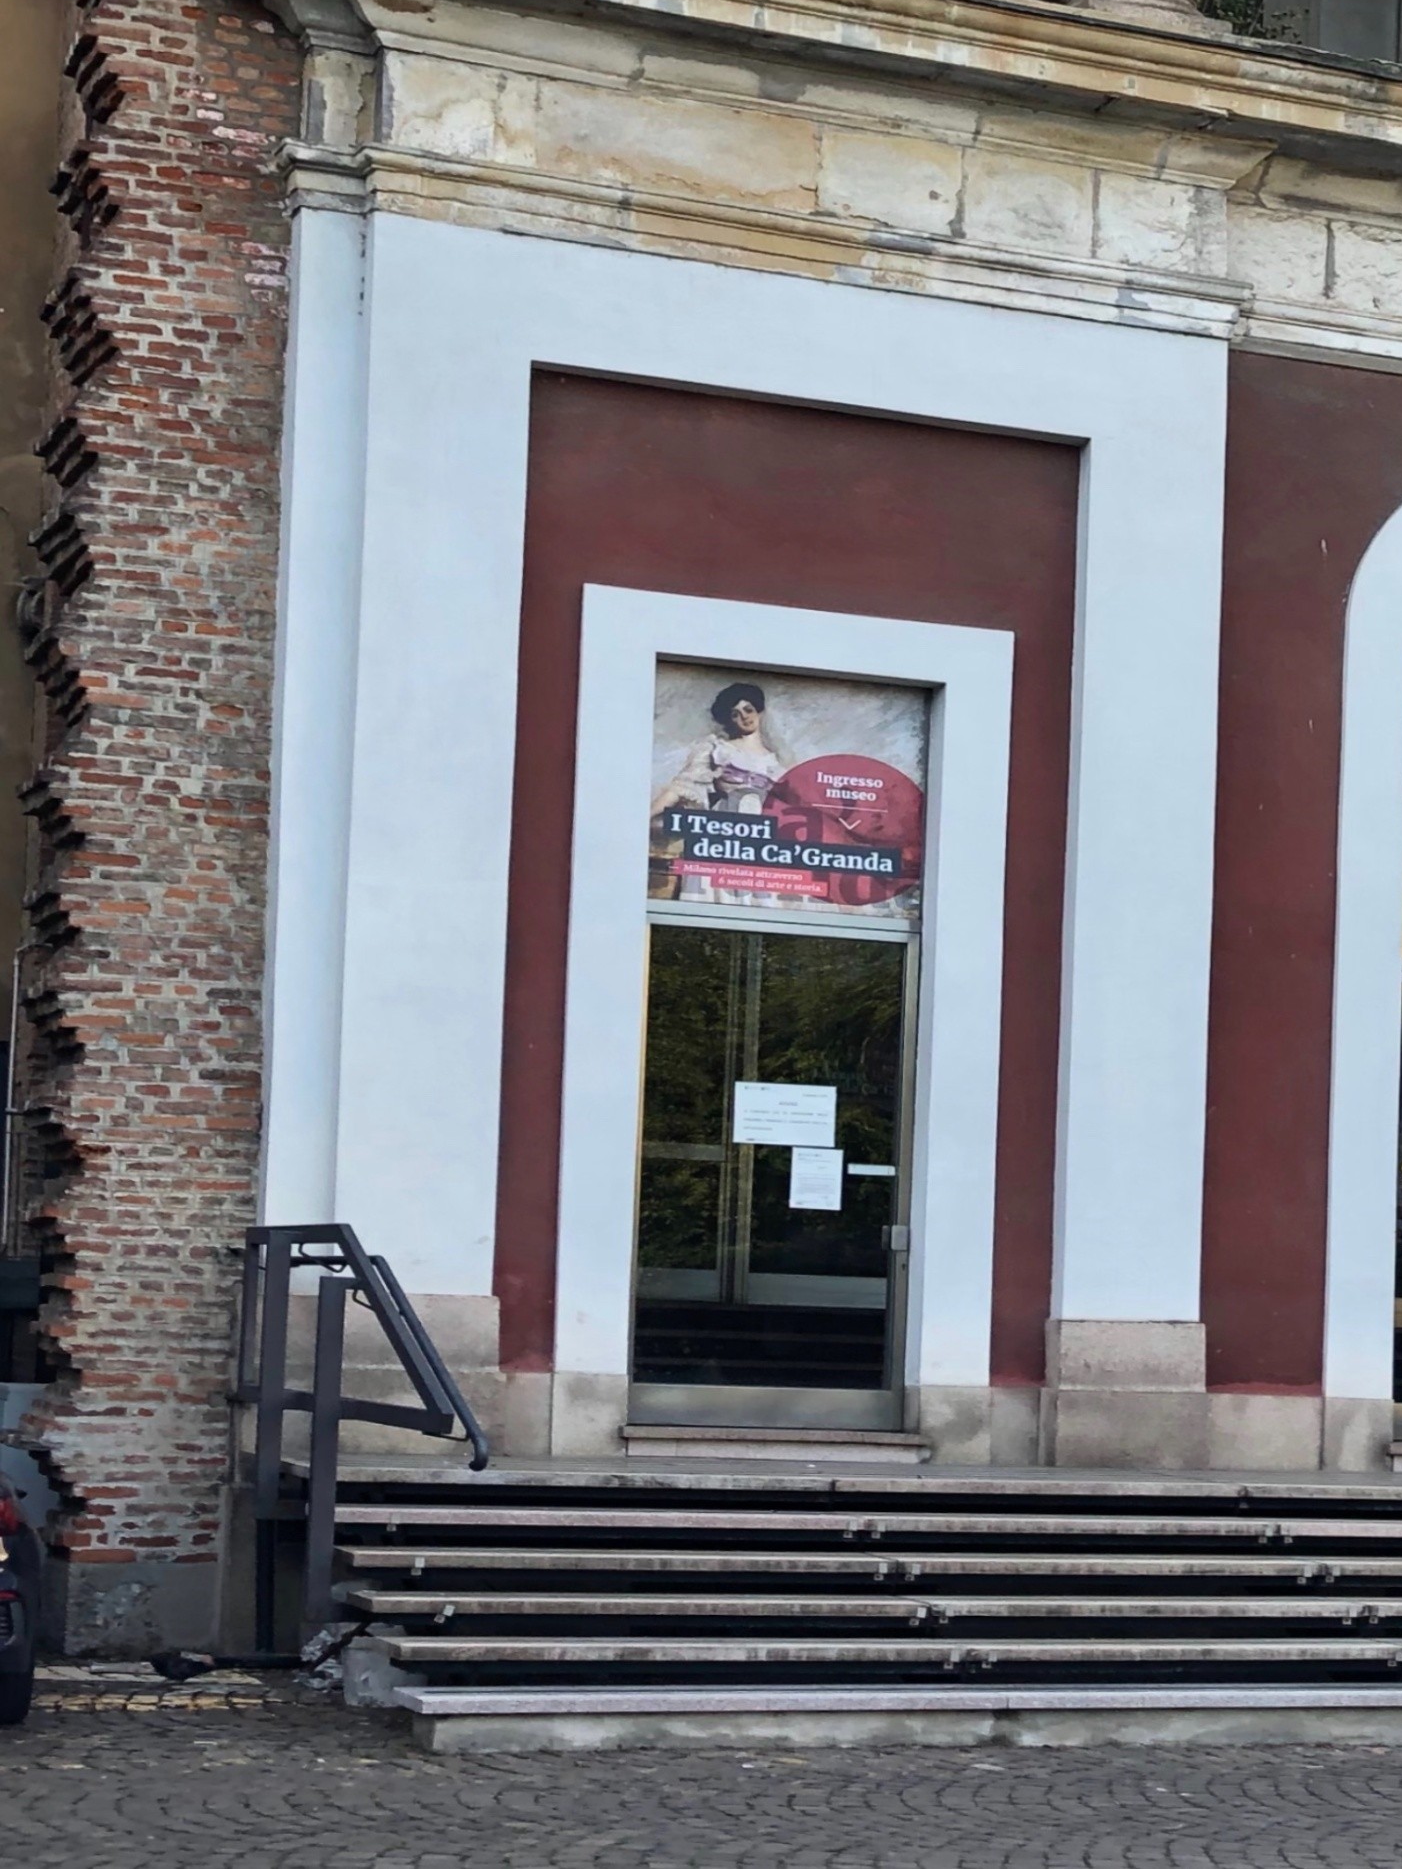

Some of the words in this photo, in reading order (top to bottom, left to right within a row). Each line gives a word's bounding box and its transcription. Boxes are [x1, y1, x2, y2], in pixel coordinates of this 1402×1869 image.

[817, 772, 883, 788] Ingresso
[825, 788, 877, 801] museo
[671, 814, 682, 832] I
[687, 815, 772, 839] Tesori
[693, 838, 755, 861] della
[683, 864, 716, 874] Milano
[718, 867, 754, 878] rivelata
[755, 869, 803, 881] attraverso
[726, 878, 753, 887] secoli
[755, 879, 764, 888] di
[766, 881, 785, 889] arte
